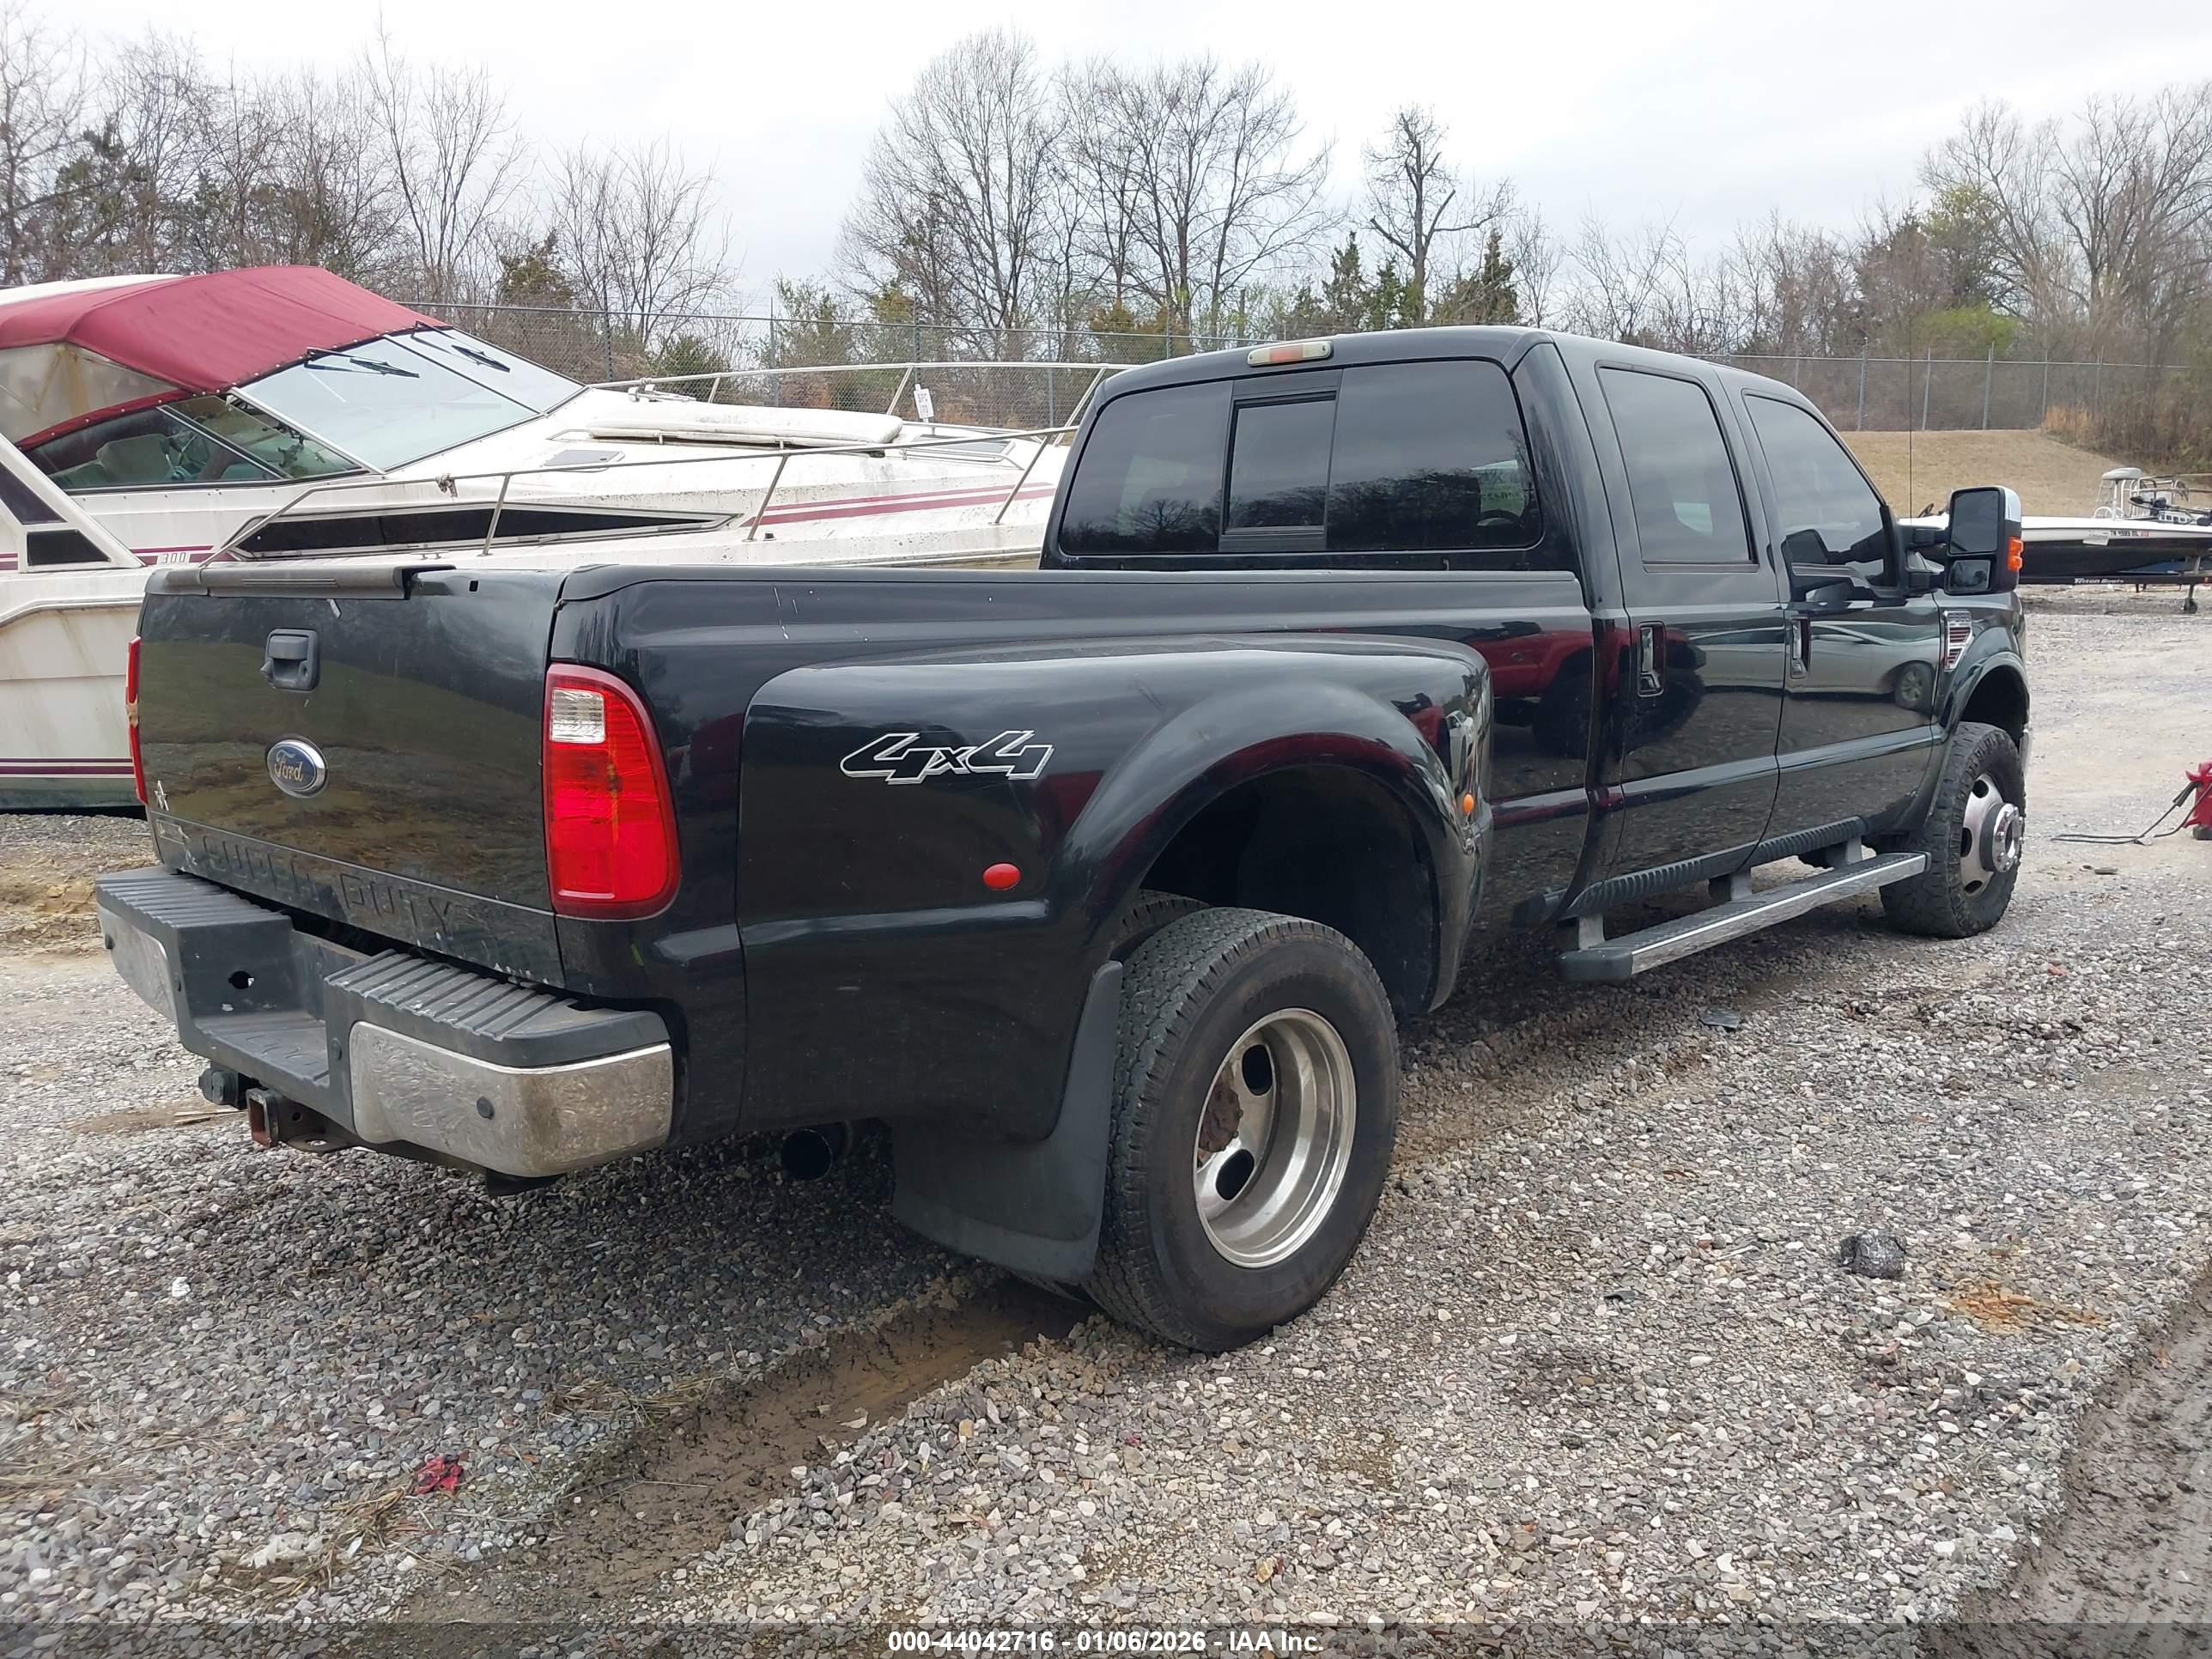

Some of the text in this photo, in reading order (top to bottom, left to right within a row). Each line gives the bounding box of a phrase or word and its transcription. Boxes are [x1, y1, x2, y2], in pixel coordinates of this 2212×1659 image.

[161, 552, 186, 564] 300
[274, 749, 304, 782] Ford
[840, 730, 1054, 785] 4x4
[338, 872, 453, 941] DUTY
